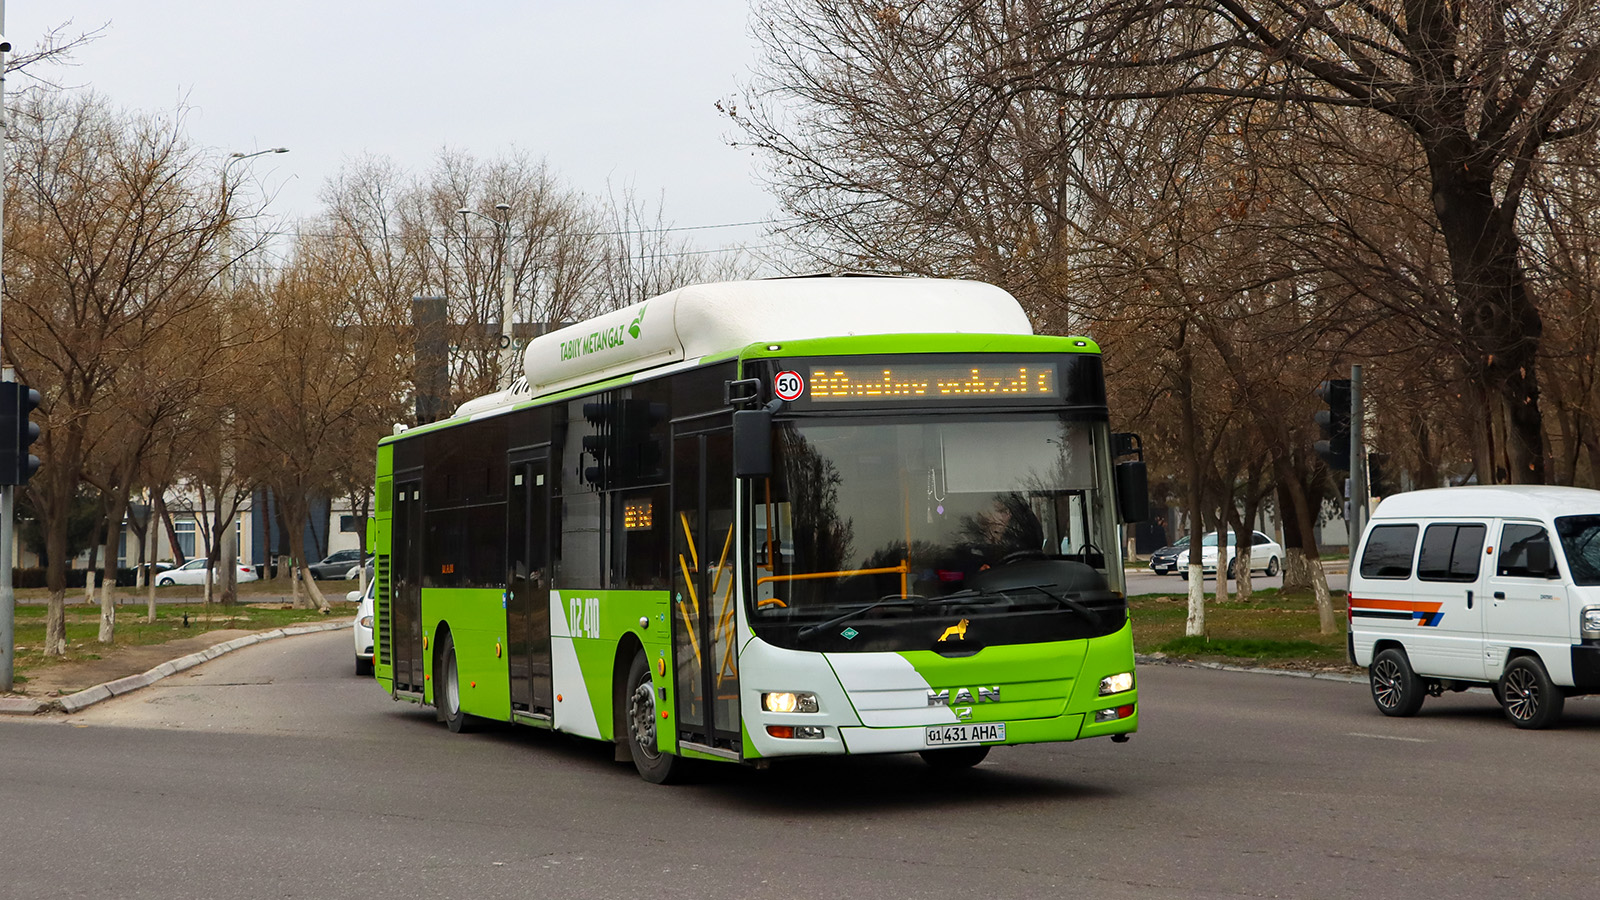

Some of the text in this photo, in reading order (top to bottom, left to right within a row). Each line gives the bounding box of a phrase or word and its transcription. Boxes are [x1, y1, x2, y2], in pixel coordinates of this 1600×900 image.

[560, 337, 583, 361] TABIIY
[779, 378, 798, 393] 50
[570, 598, 600, 639] 02 410
[927, 686, 1000, 706] MAN
[929, 730, 942, 741] 01
[944, 727, 967, 741] 431
[971, 725, 998, 740] AHA
